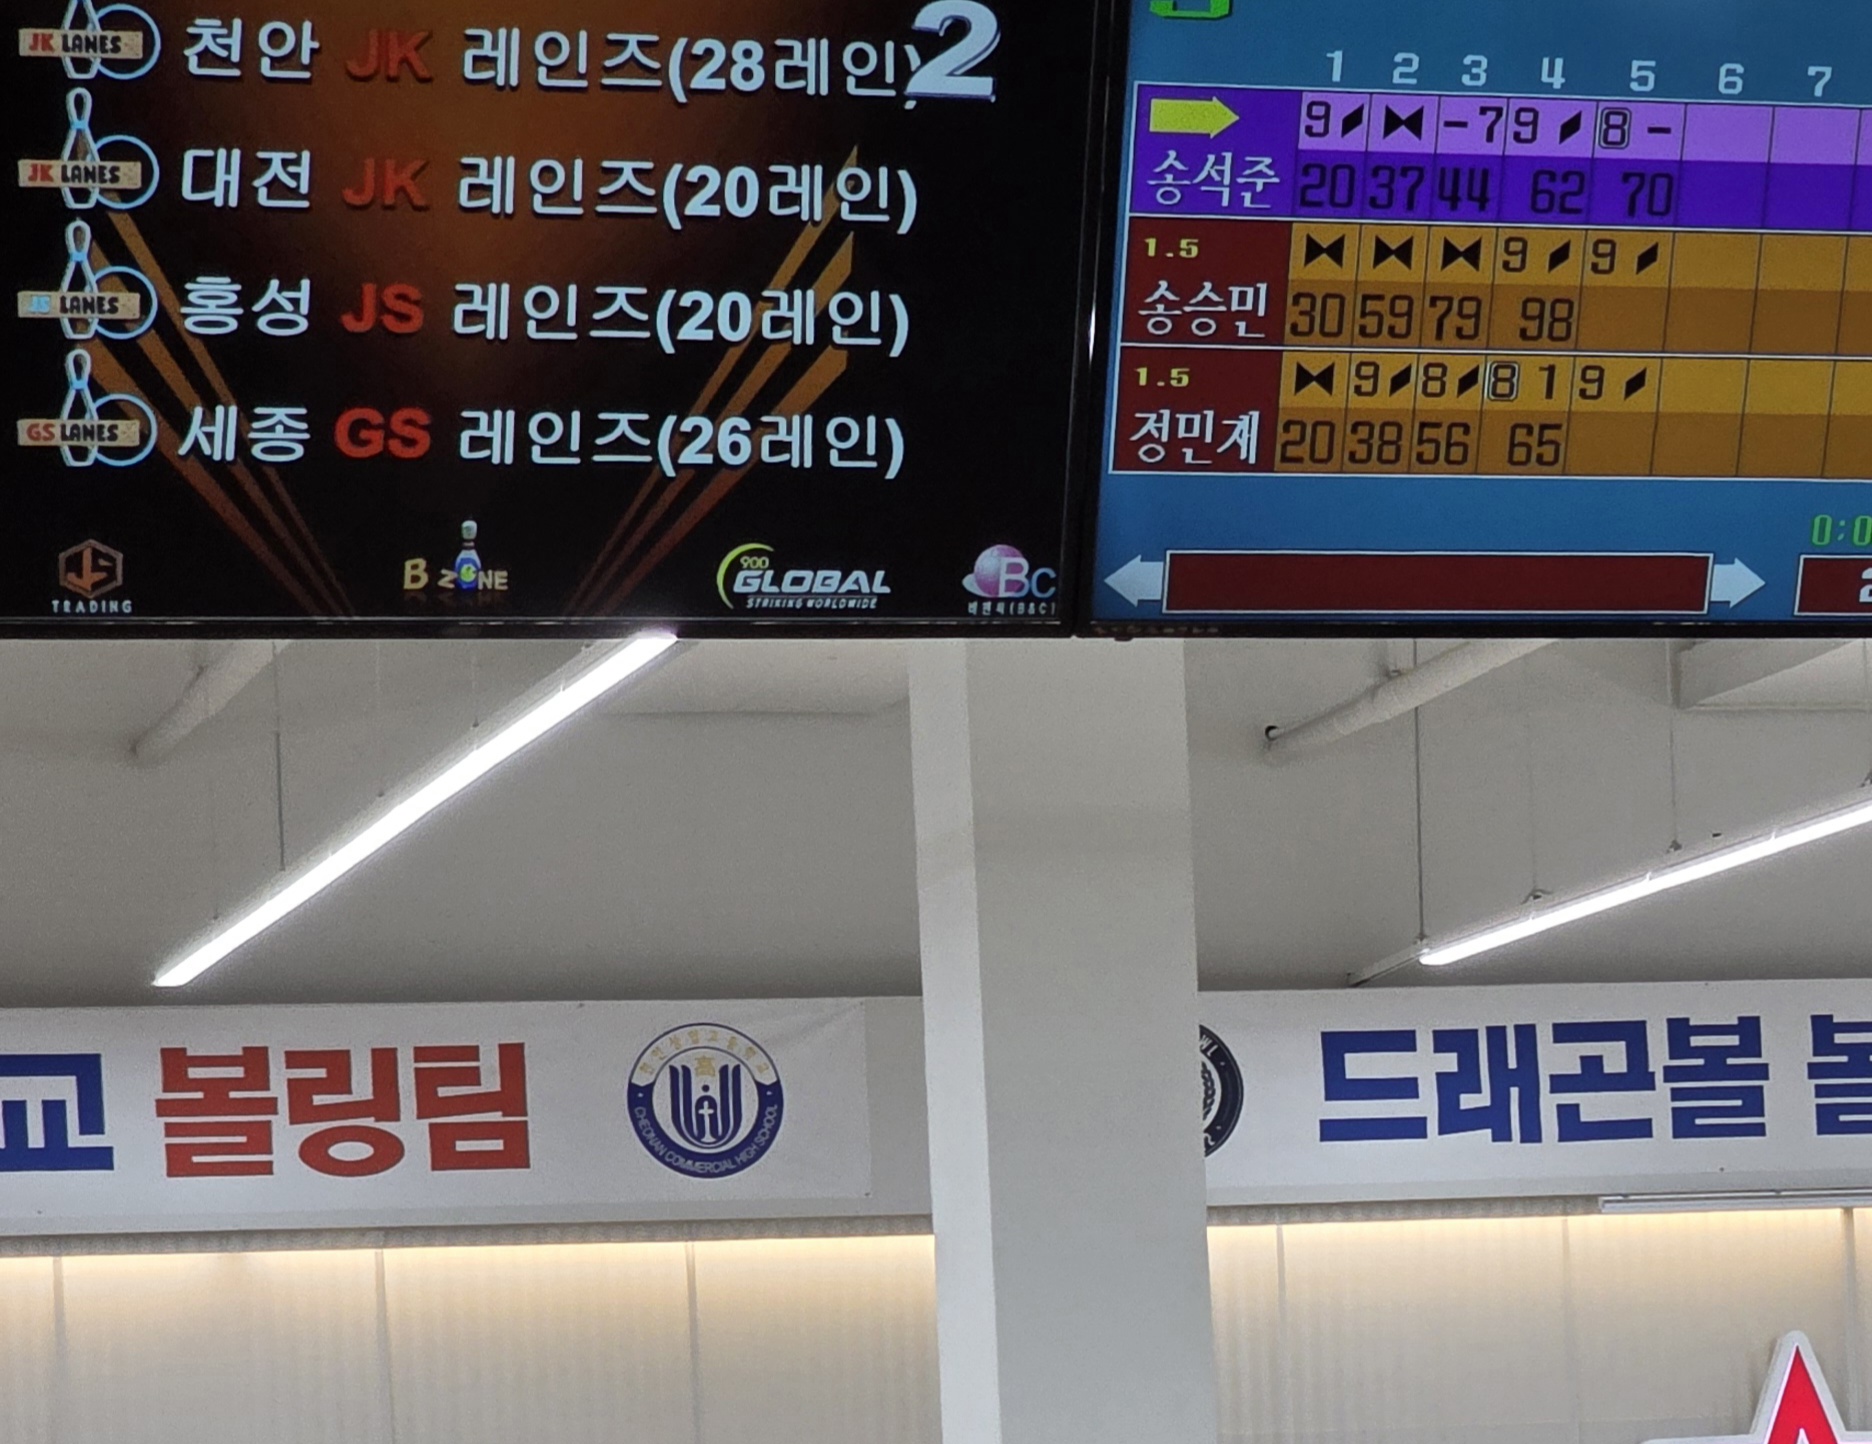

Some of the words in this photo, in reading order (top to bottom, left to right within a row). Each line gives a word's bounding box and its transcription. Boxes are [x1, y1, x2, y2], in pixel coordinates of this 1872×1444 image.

[28, 30, 54, 52] JK
[62, 30, 121, 54] LANES
[183, 17, 320, 80] 천안
[345, 29, 433, 82] JK
[908, 0, 1001, 102] 2
[1326, 50, 1343, 82] 1
[1392, 52, 1420, 84] 2
[1461, 55, 1488, 87] 3
[1541, 57, 1566, 89] 4
[1629, 60, 1657, 92] 5
[1718, 63, 1745, 94] 6
[1807, 66, 1833, 97] 7
[28, 164, 54, 183] JK
[61, 164, 121, 184] LANES
[181, 147, 311, 208] 대전
[341, 158, 430, 210] JK
[457, 156, 918, 235] 레인즈(20레인)
[1146, 150, 1280, 209] 송석준
[1301, 163, 1355, 208] 20
[1370, 165, 1424, 212] 37
[1438, 167, 1490, 212] 44
[1530, 170, 1585, 214] 62
[1621, 172, 1674, 217] 70
[1144, 238, 1199, 258] 1.5
[28, 294, 51, 314] JS
[60, 295, 119, 315] LANES
[180, 276, 311, 336] 홍성
[340, 283, 425, 335] JS
[452, 283, 909, 357] 레인즈(20레인)
[1138, 280, 1267, 338] 송승민
[1289, 292, 1344, 338] 30
[1359, 294, 1413, 340] 59
[1428, 296, 1482, 341] 79
[1519, 297, 1574, 342] 98
[1135, 367, 1190, 388] 1.5
[27, 422, 55, 442] GS
[60, 422, 118, 442] LANES
[178, 404, 311, 462] 세종
[333, 407, 431, 459] GS
[459, 410, 905, 480] 레인즈(26레인)
[1129, 409, 1260, 466] 정민재
[1279, 420, 1335, 466] 20
[1348, 421, 1403, 466] 38
[1415, 422, 1471, 467] 56
[1507, 423, 1563, 468] 65
[403, 558, 428, 591] B
[733, 570, 891, 593] GLOBAL
[740, 556, 769, 570] 900
[999, 557, 1056, 598] BC
[52, 600, 133, 614] TRADING
[746, 598, 803, 610] STRIKING
[807, 597, 878, 610] WORLDWIDE
[1319, 1014, 1770, 1143] 드래곤볼
[155, 1042, 531, 1178] 볼링팀
[634, 1106, 668, 1156] CHEONAN
[665, 1151, 737, 1173] COMMERCIAL
[754, 1104, 778, 1146] SCHOOL
